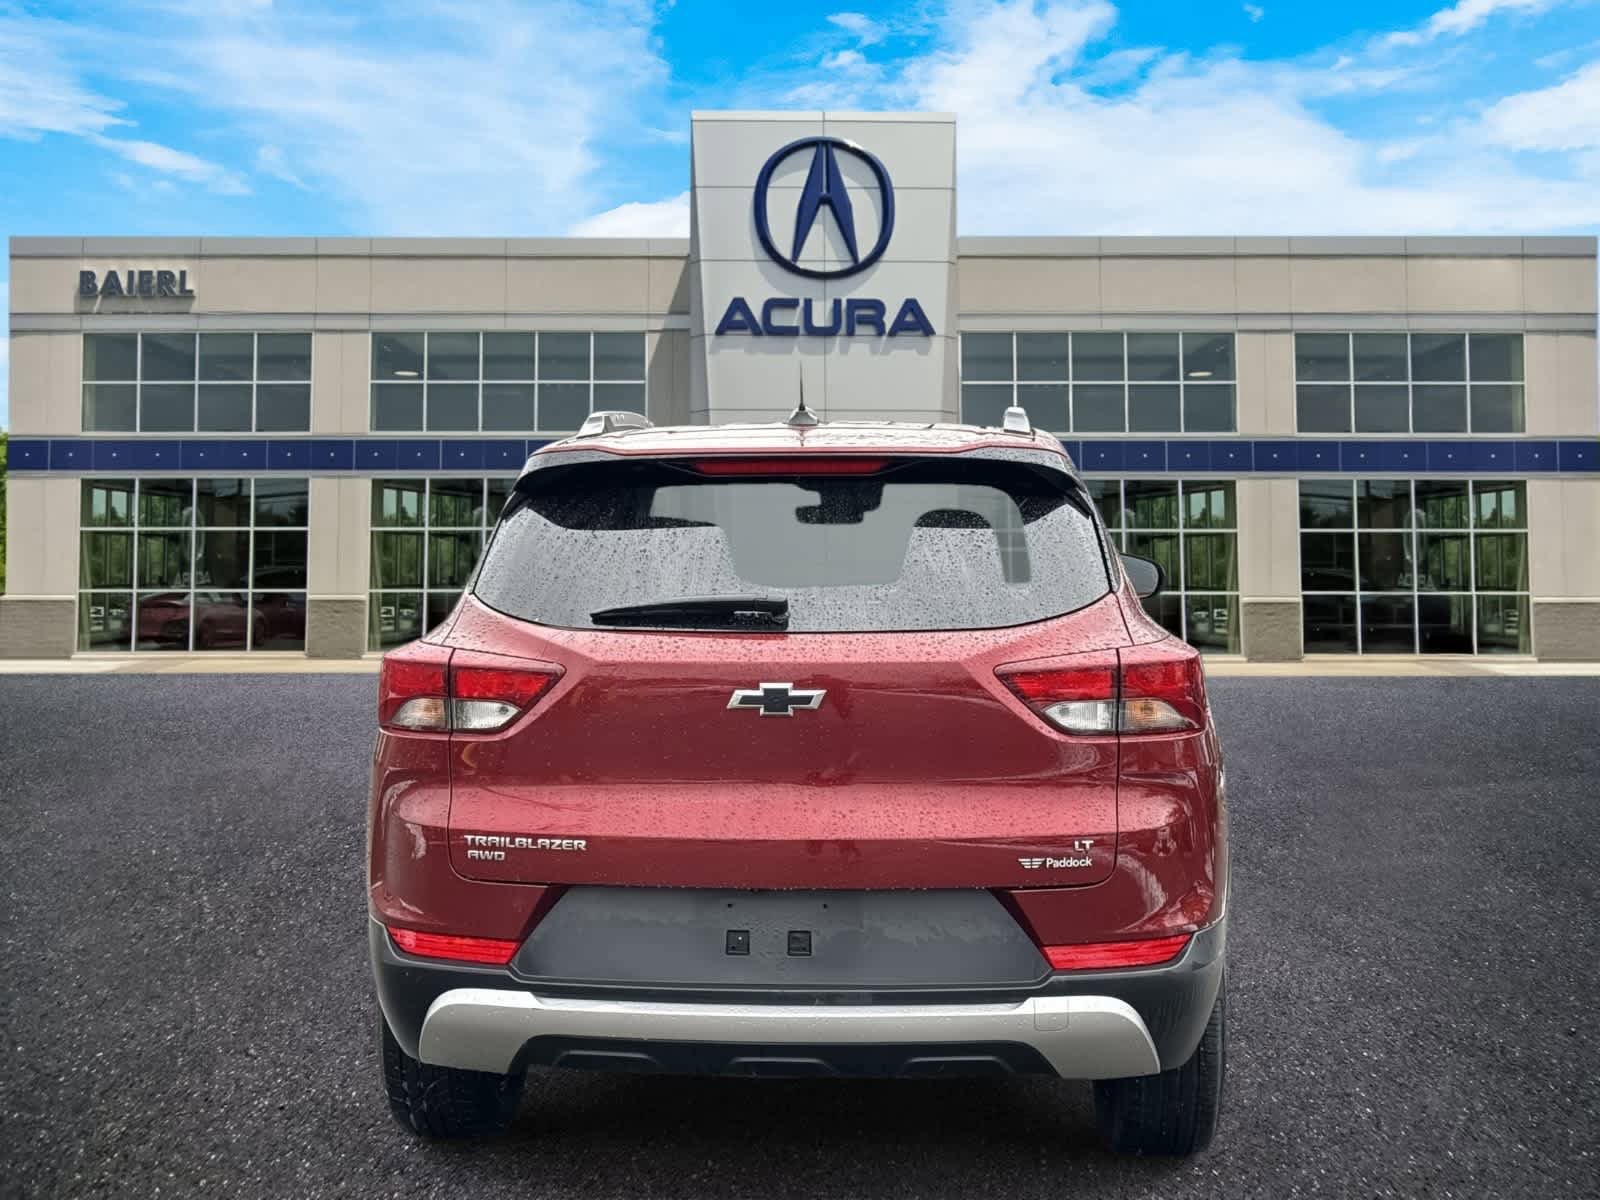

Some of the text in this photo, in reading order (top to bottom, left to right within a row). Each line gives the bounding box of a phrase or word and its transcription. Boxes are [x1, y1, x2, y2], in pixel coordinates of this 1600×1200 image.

[79, 269, 194, 296] BAIERL
[715, 297, 936, 336] ACURA
[464, 835, 587, 850] TRAILBLAZER
[1074, 840, 1094, 851] LT
[467, 850, 505, 861] AWD
[1046, 857, 1092, 868] Paddock
